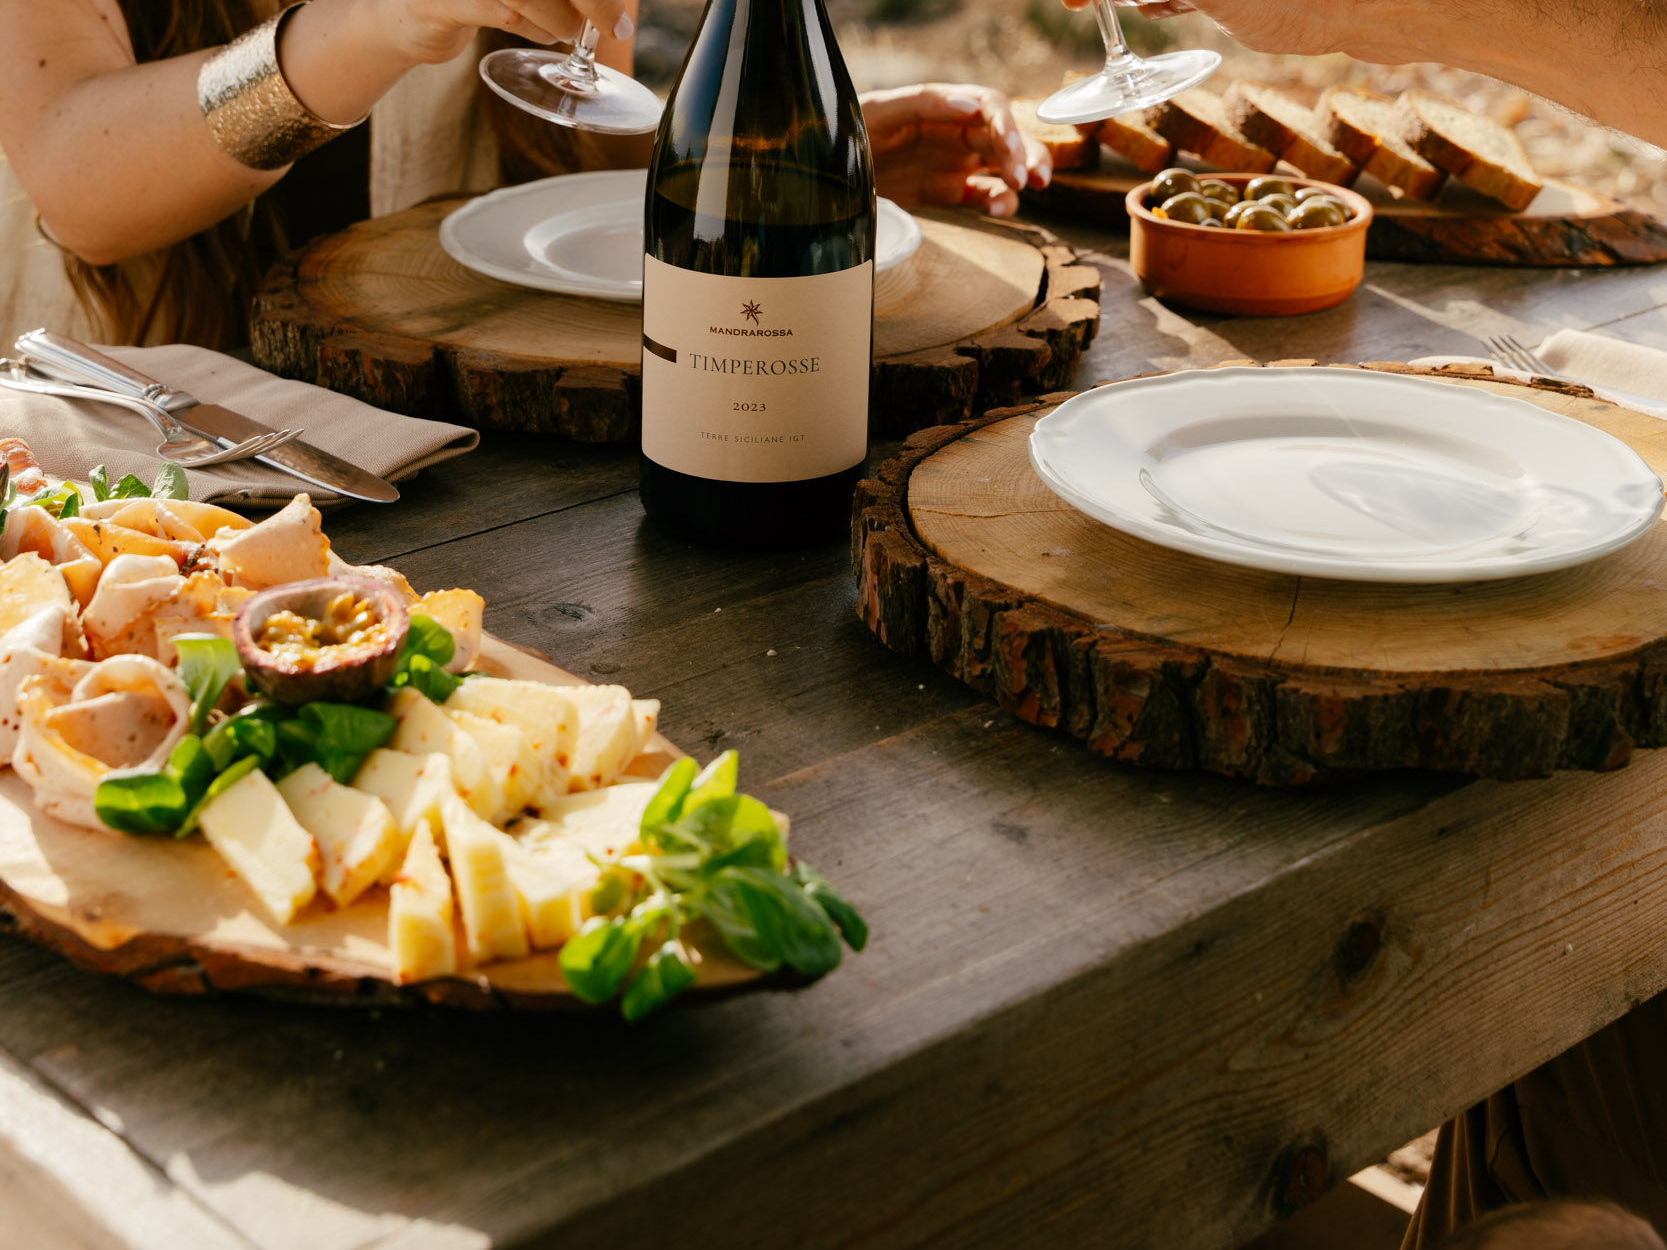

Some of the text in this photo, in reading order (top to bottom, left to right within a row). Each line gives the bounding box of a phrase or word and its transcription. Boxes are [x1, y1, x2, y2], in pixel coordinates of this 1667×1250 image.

[709, 326, 793, 337] MANDRAROSSA
[689, 353, 821, 376] TIMPEROSSE
[733, 402, 766, 412] 2023
[700, 431, 806, 443] TERRE SICILIANE IGT
